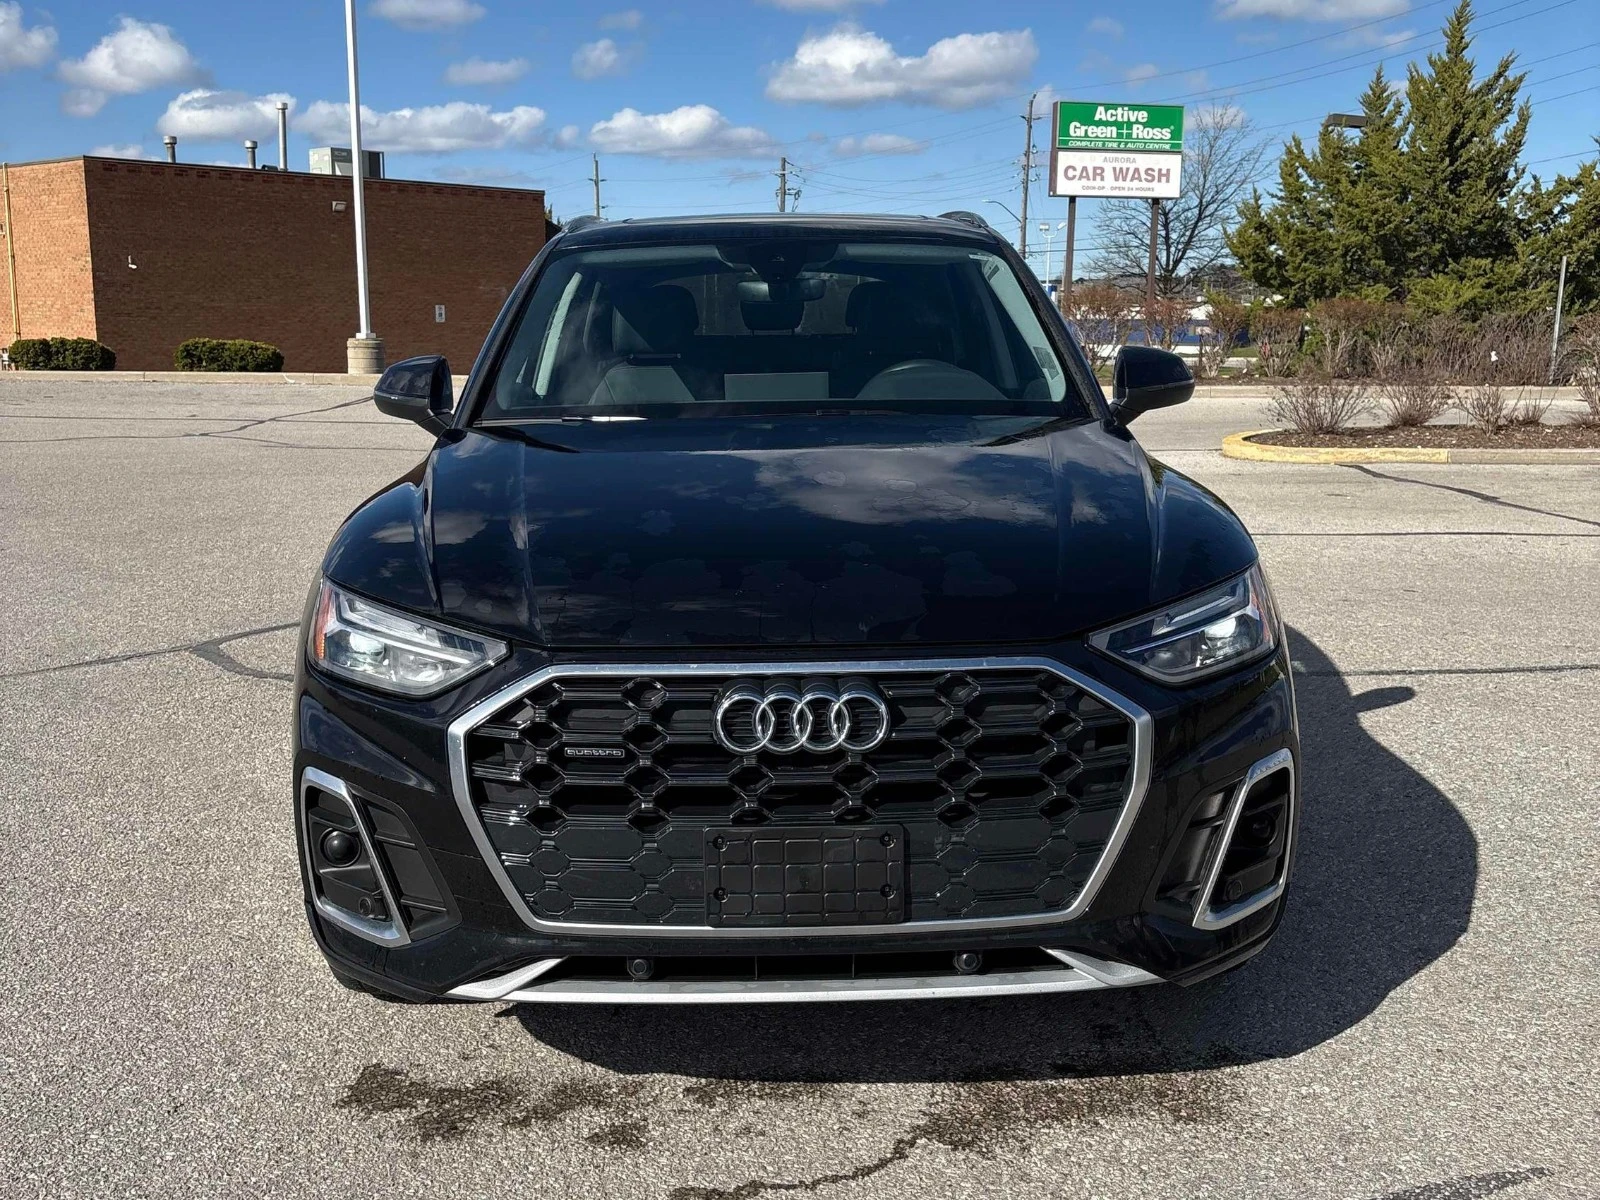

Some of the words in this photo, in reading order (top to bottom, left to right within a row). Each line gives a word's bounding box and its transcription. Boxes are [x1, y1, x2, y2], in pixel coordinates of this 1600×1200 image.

[1094, 105, 1148, 122] Active
[1068, 140, 1103, 148] COMPLETE
[1103, 156, 1136, 164] AURORA
[1063, 165, 1105, 182] CAR
[1112, 166, 1171, 184] WASH
